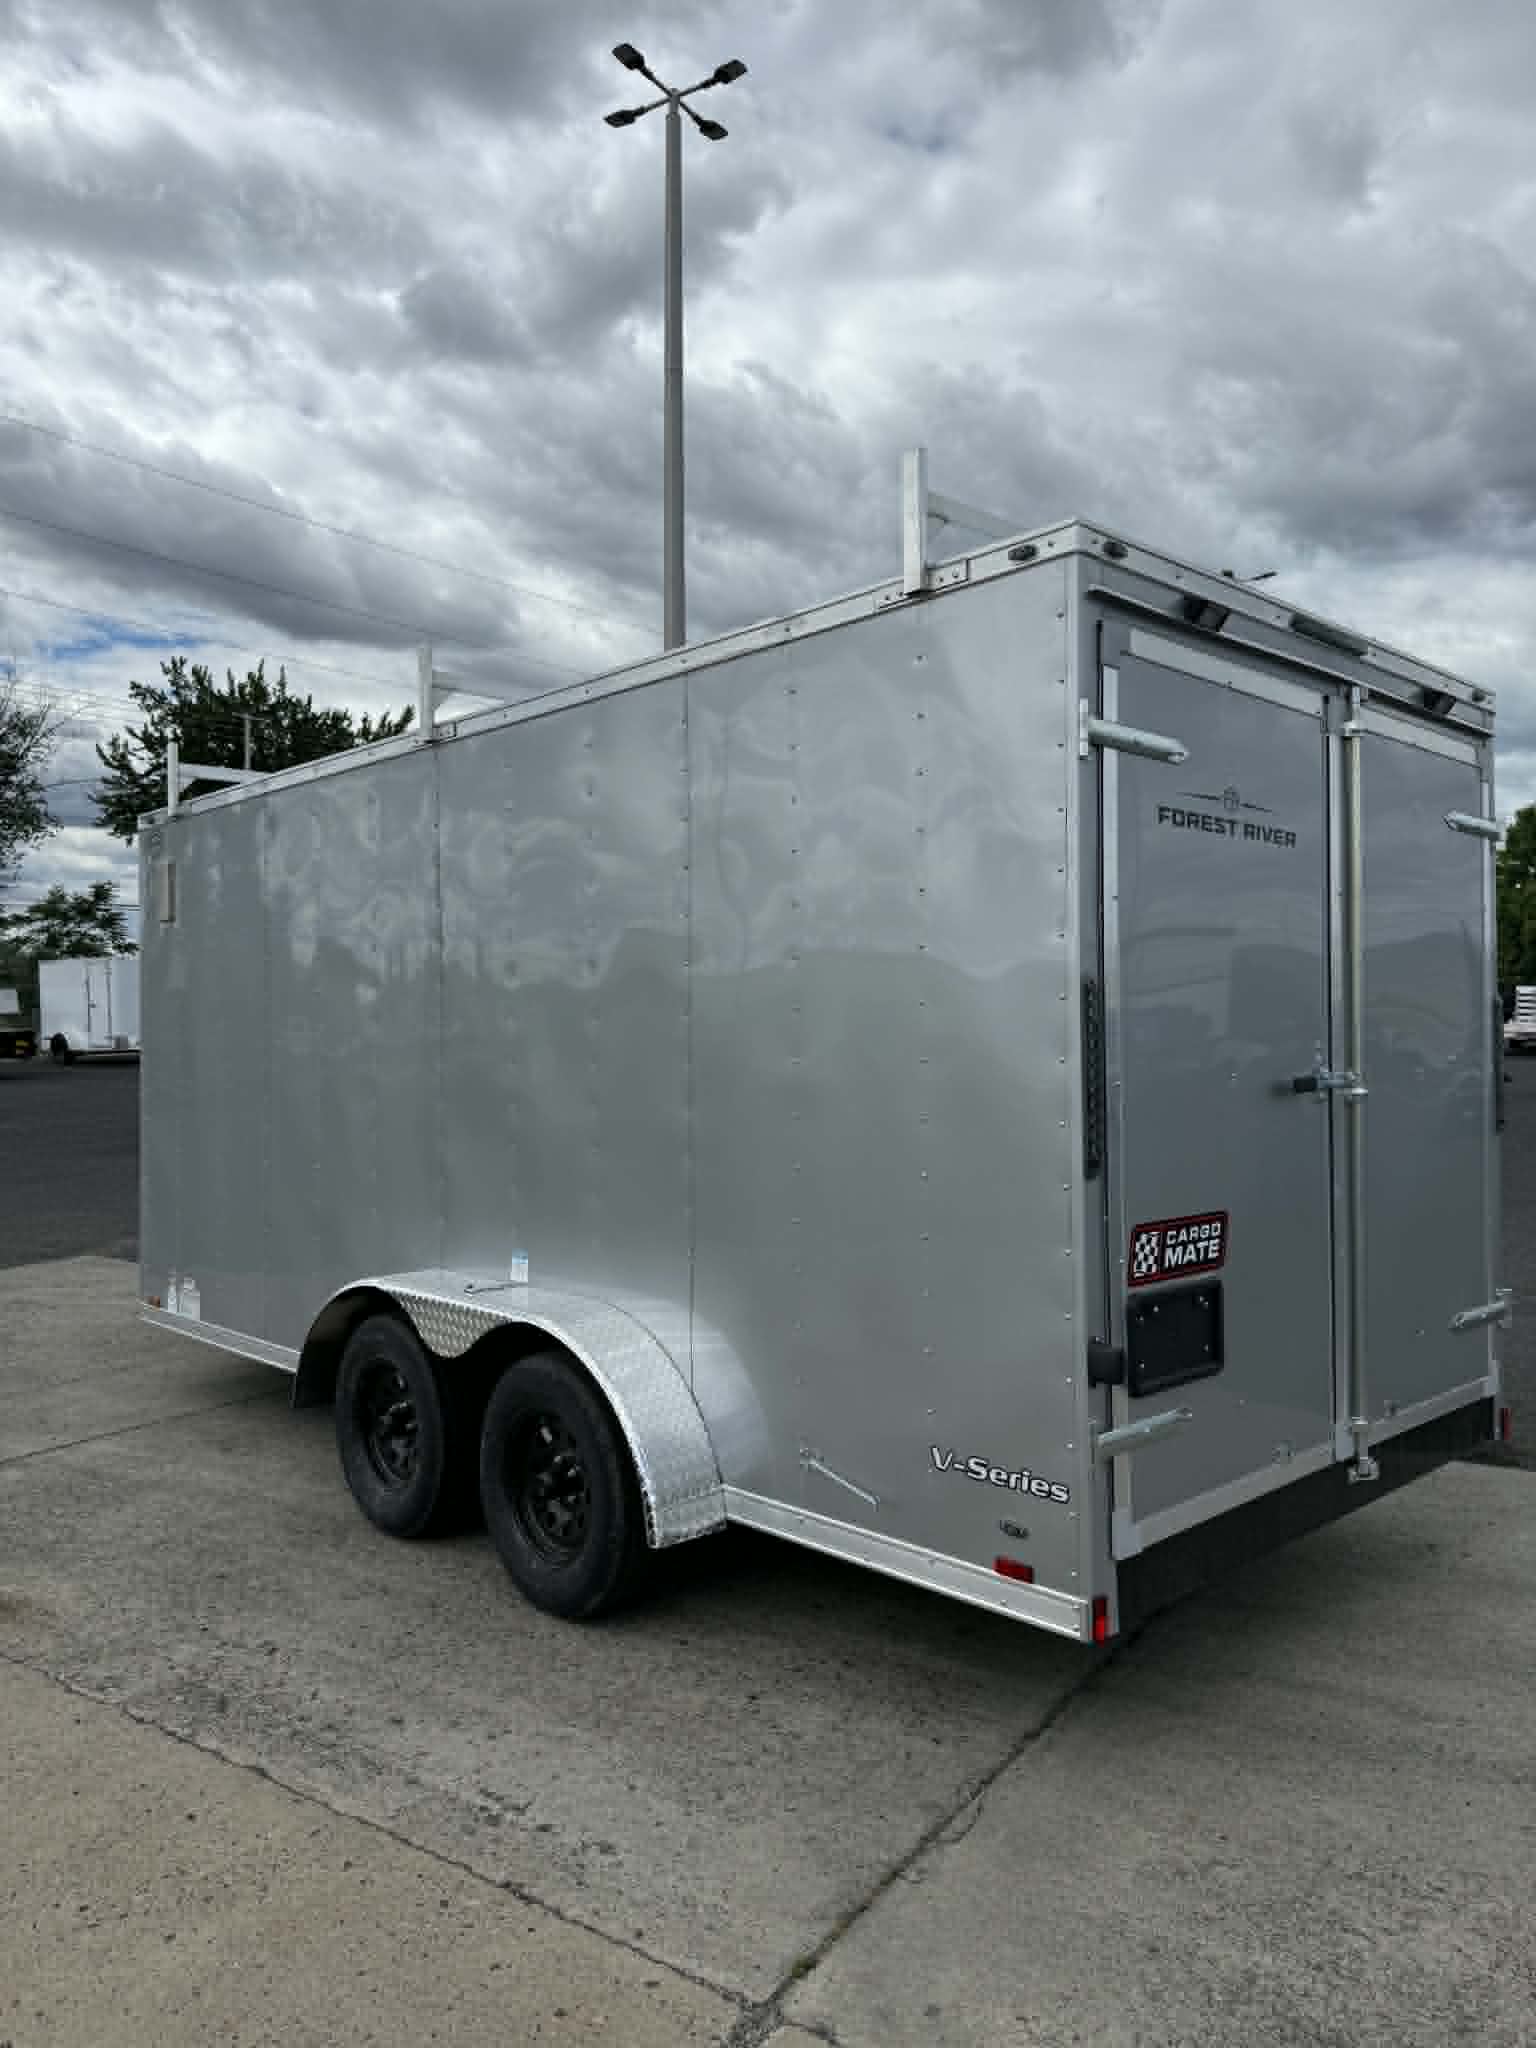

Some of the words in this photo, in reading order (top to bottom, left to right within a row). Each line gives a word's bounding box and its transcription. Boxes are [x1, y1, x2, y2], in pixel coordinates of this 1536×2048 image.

[1158, 806, 1239, 838] FOREST
[1243, 823, 1297, 849] RIVER
[1166, 1223, 1221, 1245] CARGO
[1164, 1238, 1220, 1269] MATE
[930, 1446, 1071, 1504] V-Series
